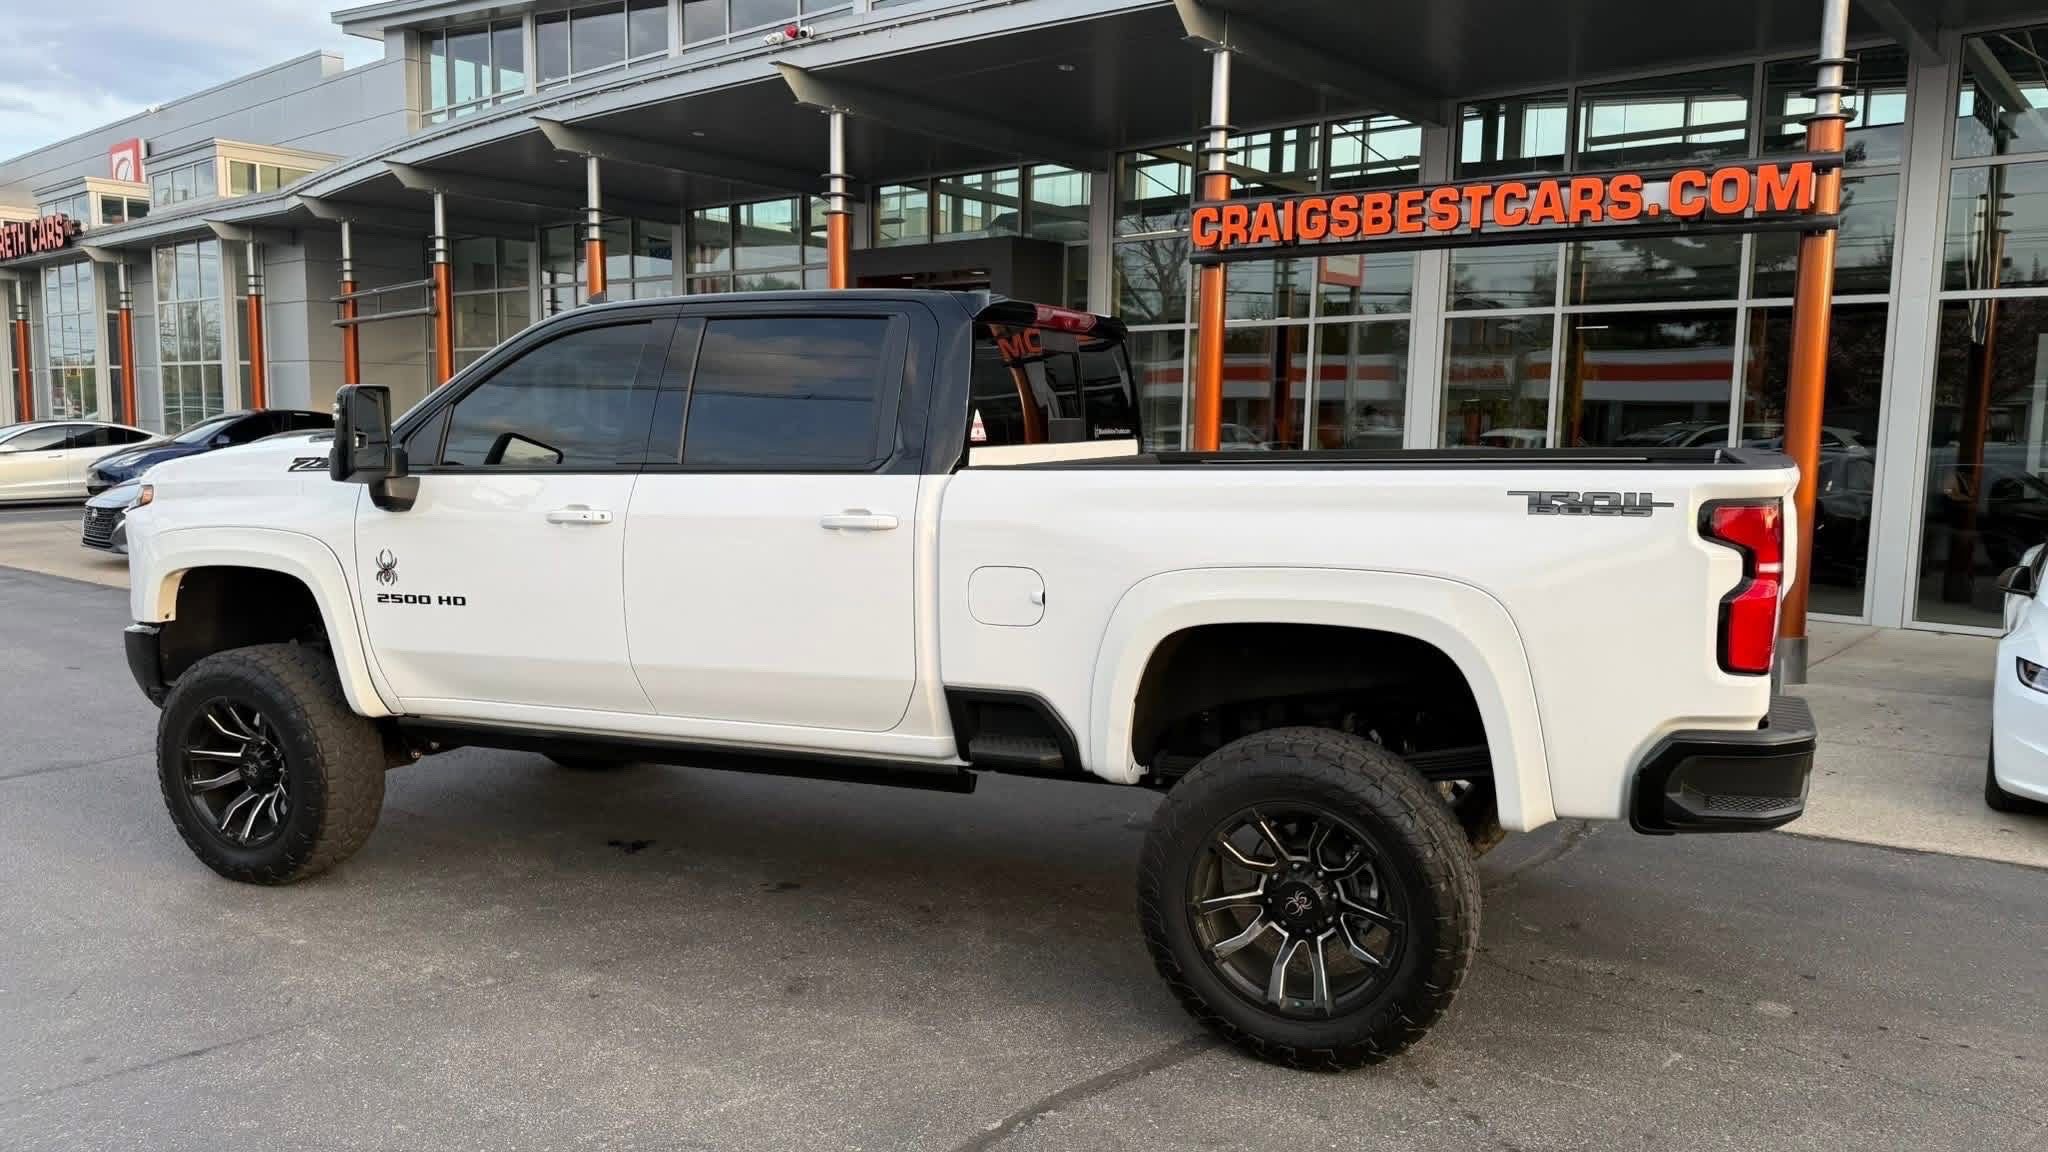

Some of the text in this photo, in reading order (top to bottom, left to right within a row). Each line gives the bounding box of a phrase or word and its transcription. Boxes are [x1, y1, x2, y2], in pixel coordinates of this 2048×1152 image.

[1192, 161, 1814, 248] CRAIGSBESTCARS.COM
[31, 214, 64, 253] CARS
[377, 594, 466, 606] 2500 HD
